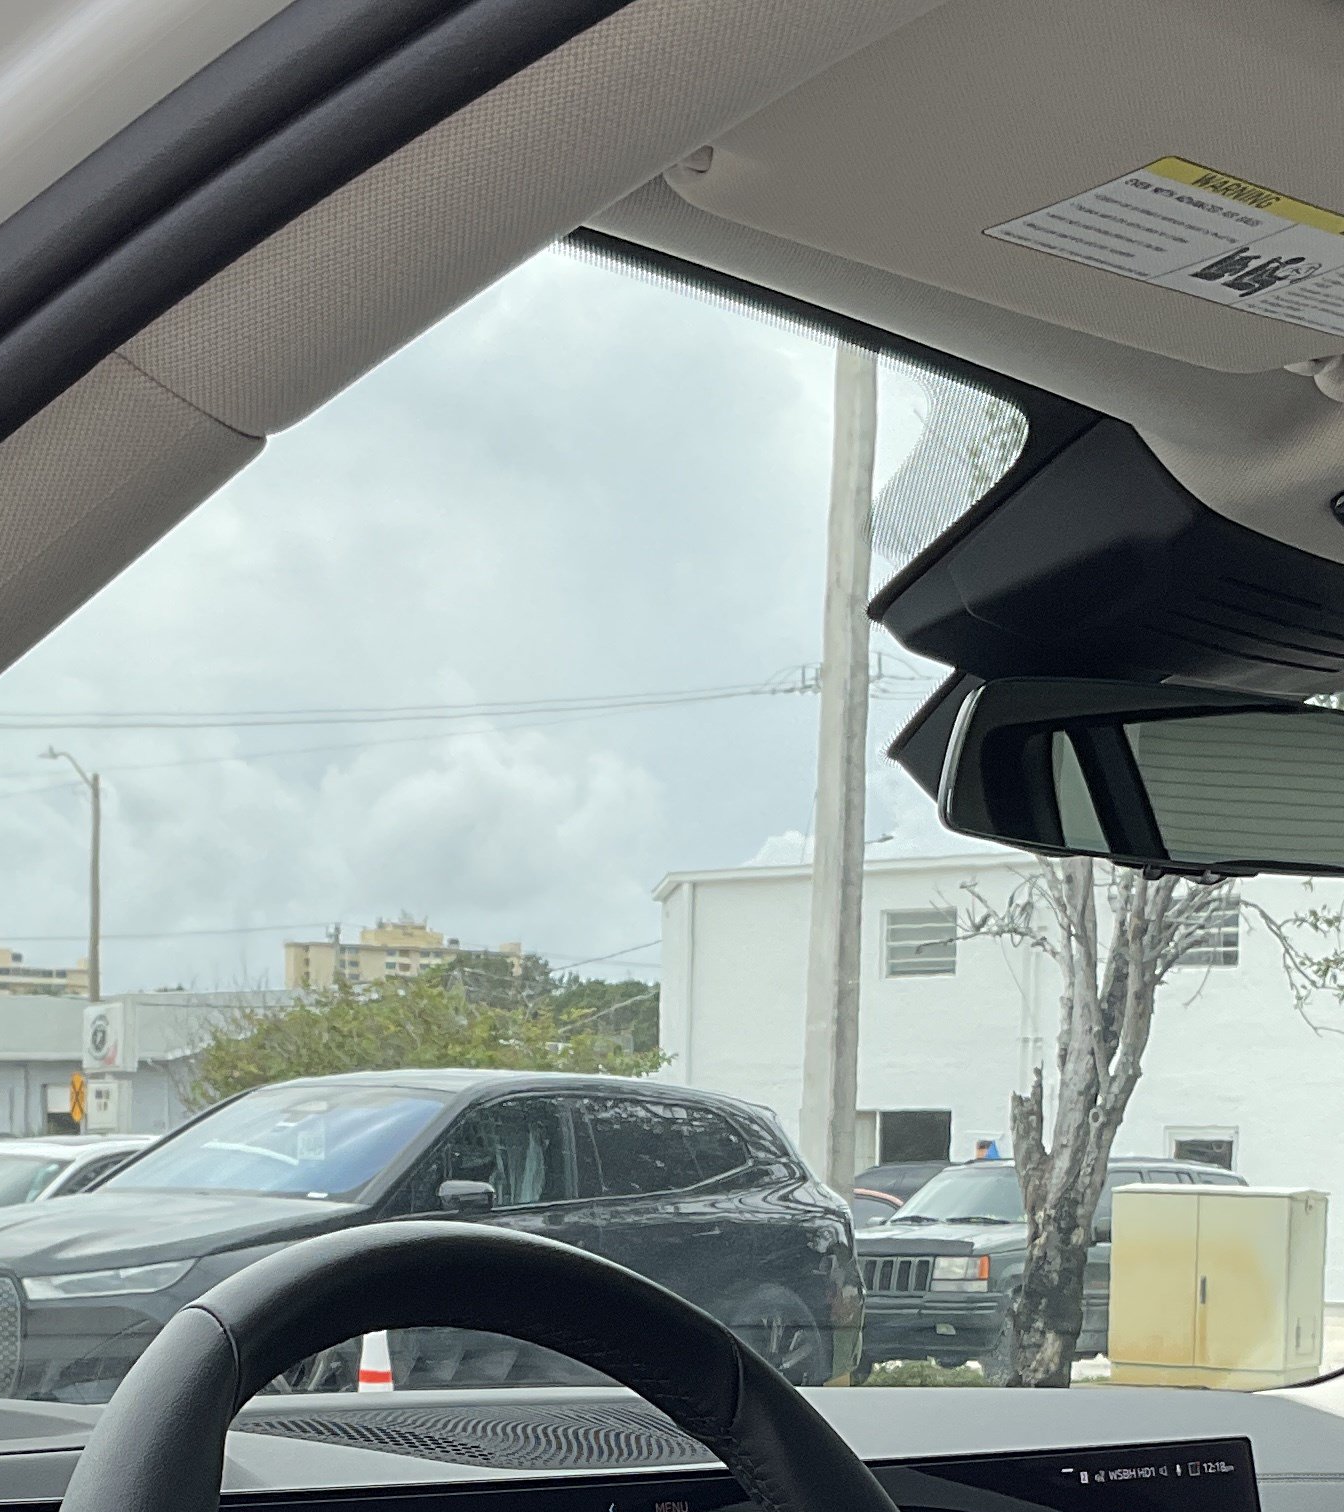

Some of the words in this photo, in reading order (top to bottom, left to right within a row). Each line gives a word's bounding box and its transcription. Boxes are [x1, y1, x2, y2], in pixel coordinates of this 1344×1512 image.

[1192, 173, 1280, 208] WARNING
[1109, 1468, 1137, 1481] WSBH
[1138, 1467, 1156, 1479] HD1
